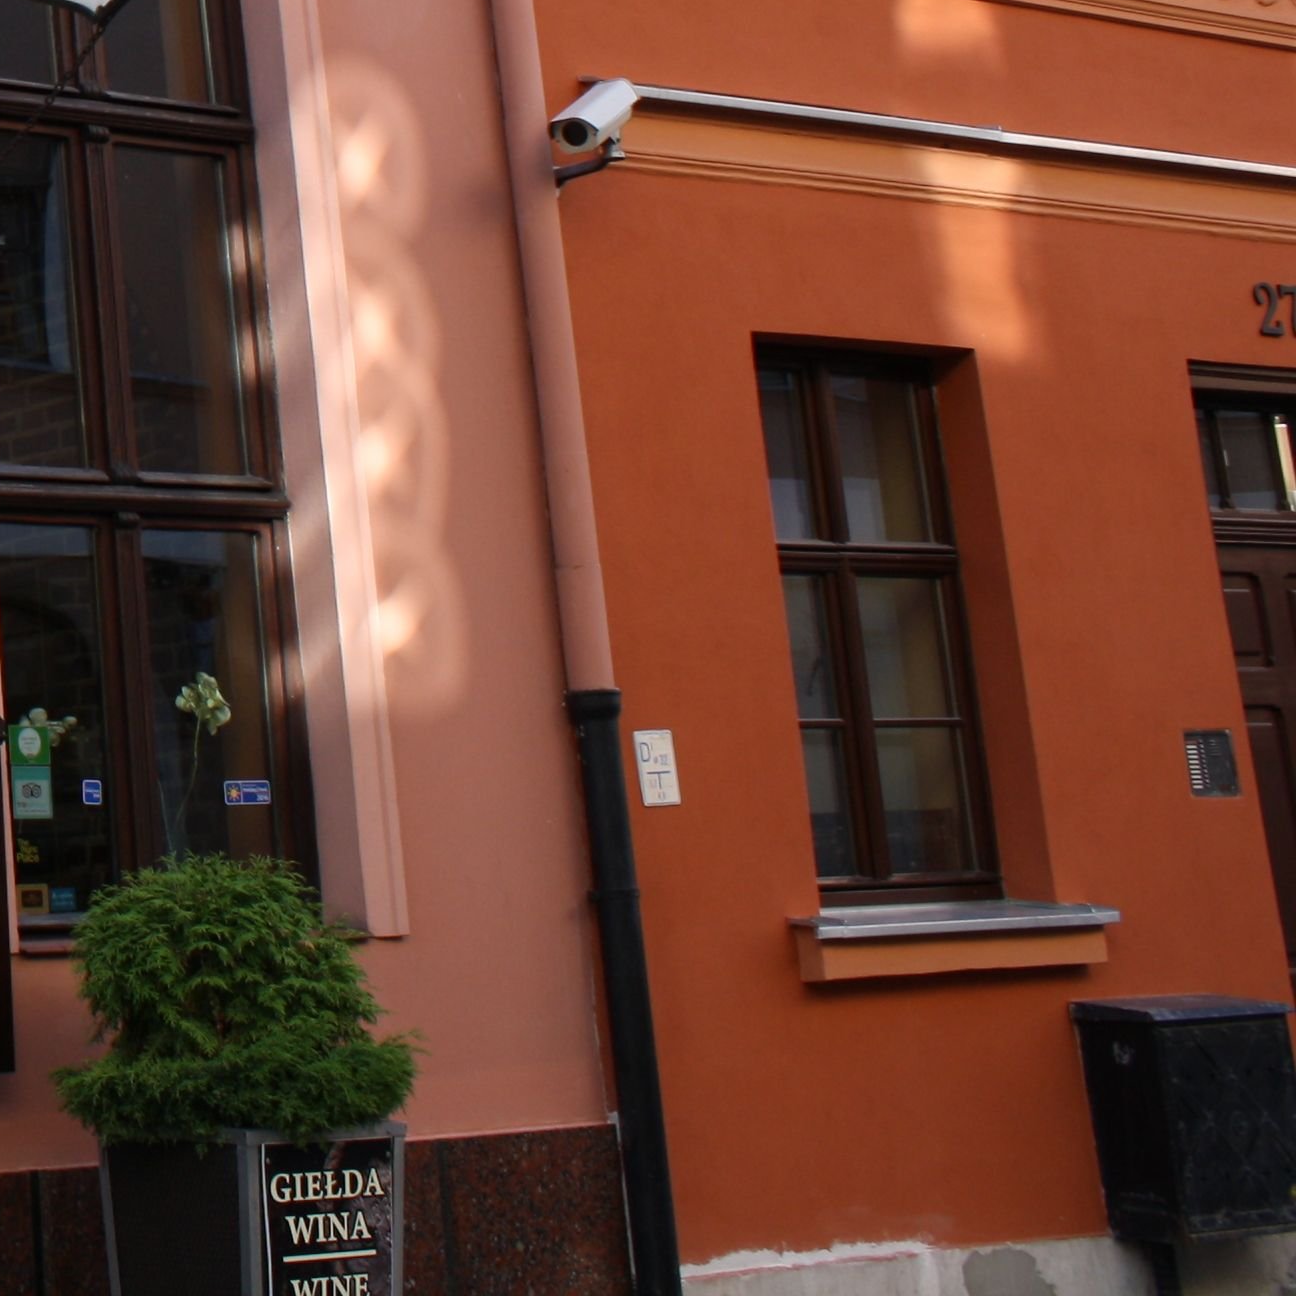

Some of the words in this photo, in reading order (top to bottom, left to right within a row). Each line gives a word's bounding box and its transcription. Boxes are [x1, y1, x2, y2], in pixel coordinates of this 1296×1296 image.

[270, 1168, 384, 1203] GIEŁDA
[285, 1211, 372, 1245] WINA
[290, 1273, 370, 1296] WINE
